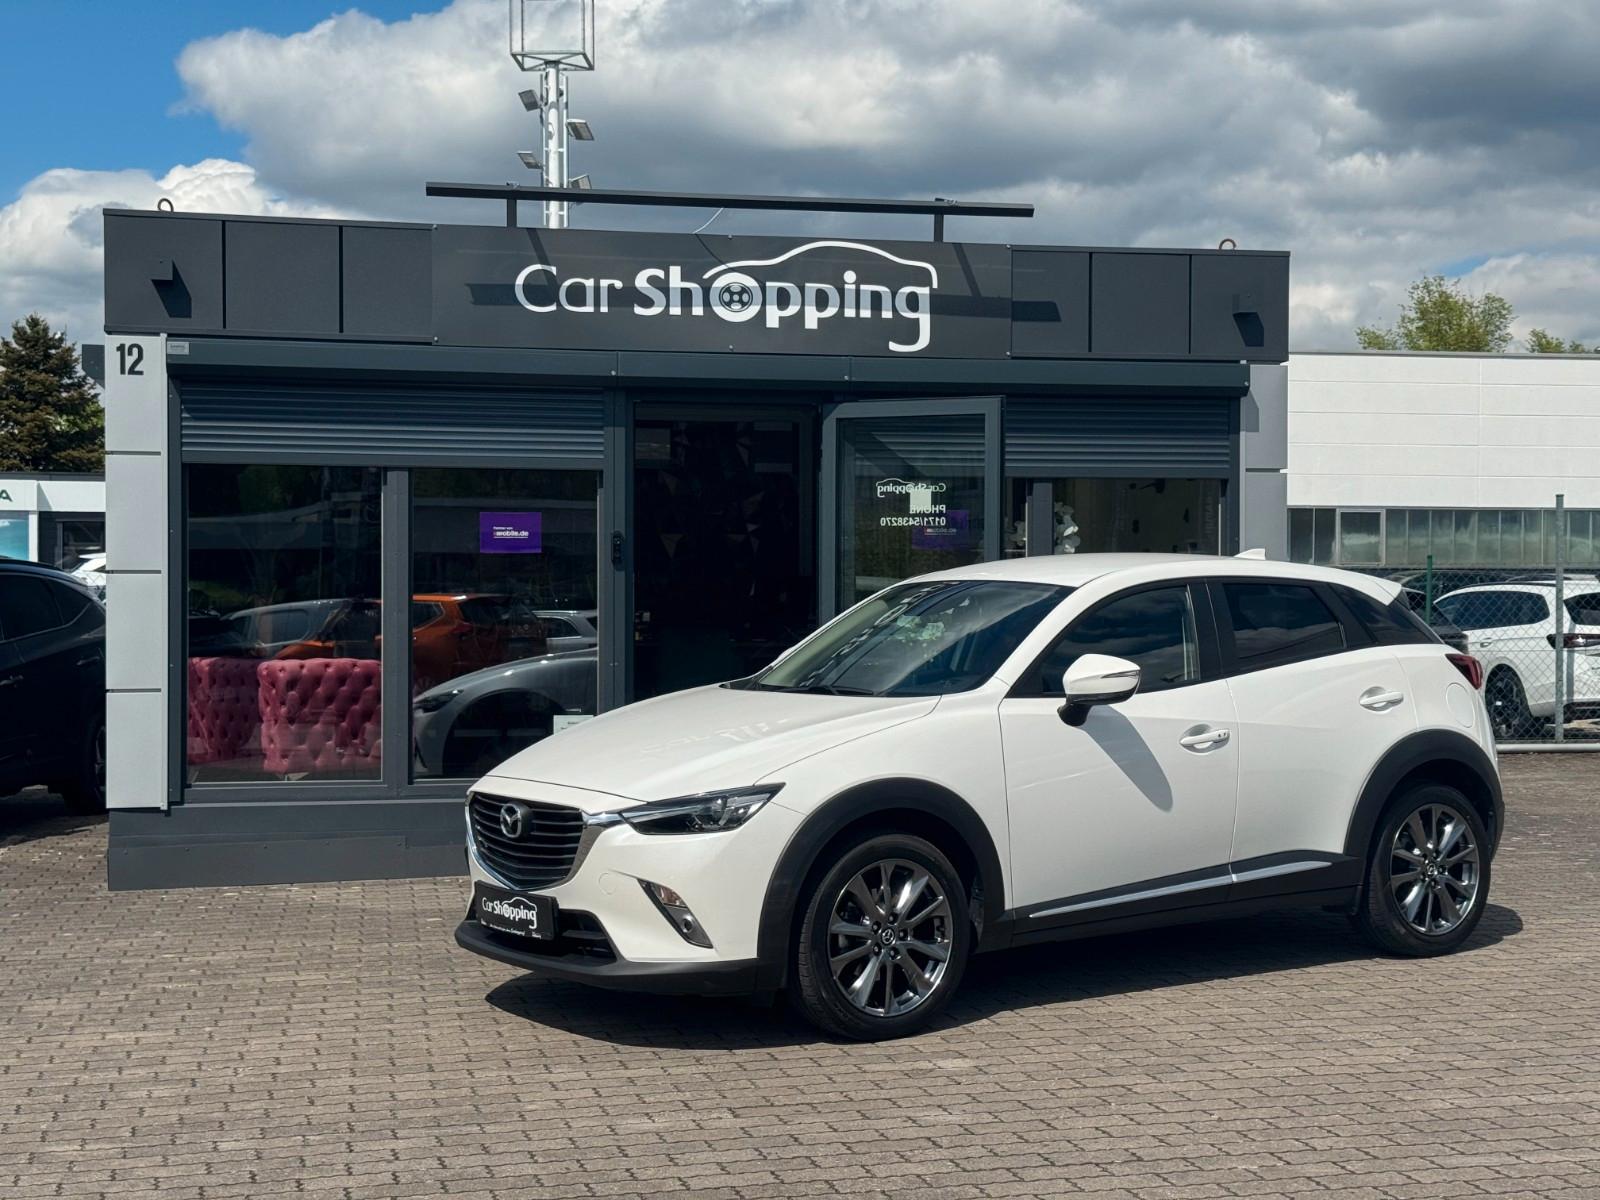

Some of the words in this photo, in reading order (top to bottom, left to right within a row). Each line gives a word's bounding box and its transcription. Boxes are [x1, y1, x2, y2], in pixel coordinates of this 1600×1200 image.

[514, 263, 624, 313] Car
[633, 265, 931, 352] Shopping
[116, 342, 145, 376] 12
